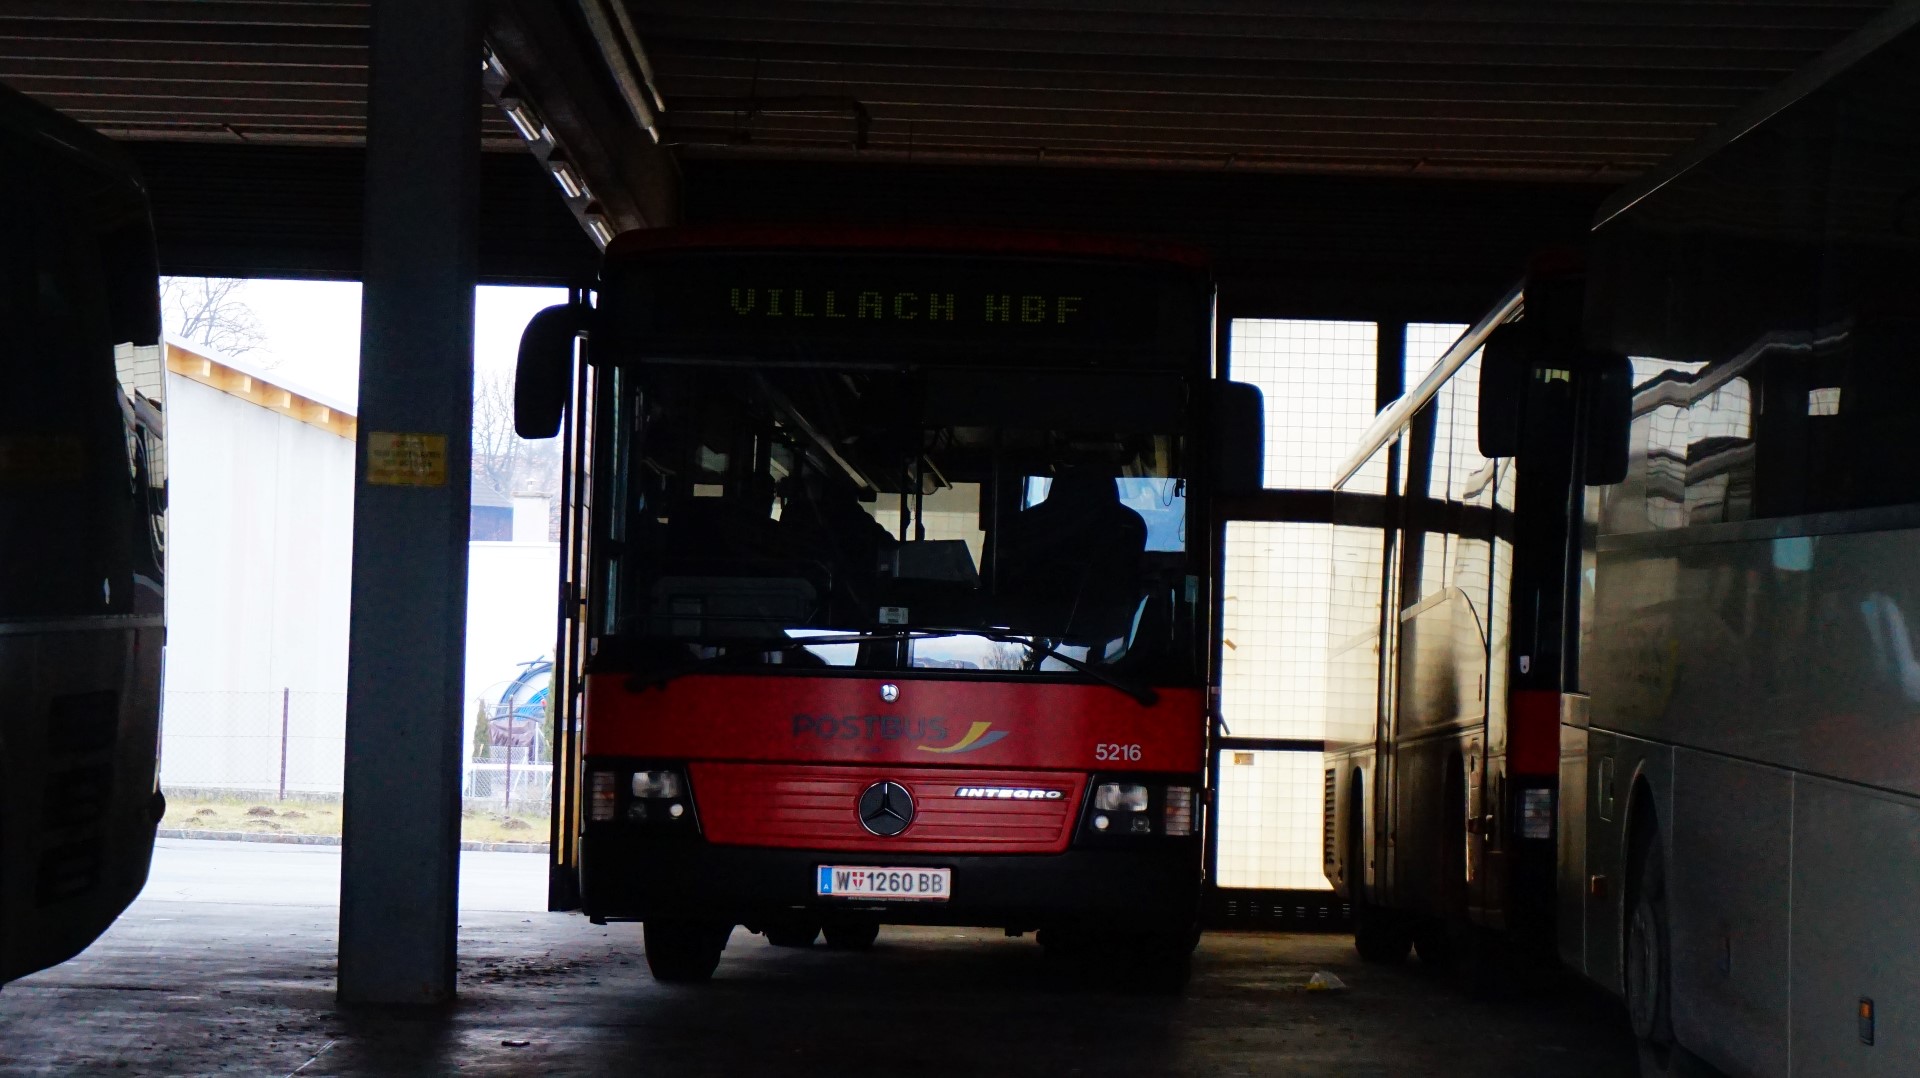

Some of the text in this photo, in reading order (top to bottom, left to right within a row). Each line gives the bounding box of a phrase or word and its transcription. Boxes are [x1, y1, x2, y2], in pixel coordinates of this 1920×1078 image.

[729, 287, 1083, 324] VILLACH HBF
[793, 714, 948, 741] POSTBUS
[1095, 743, 1143, 762] 5216
[957, 787, 1064, 800] INTEGRO
[837, 872, 943, 892] W 1260 BB
